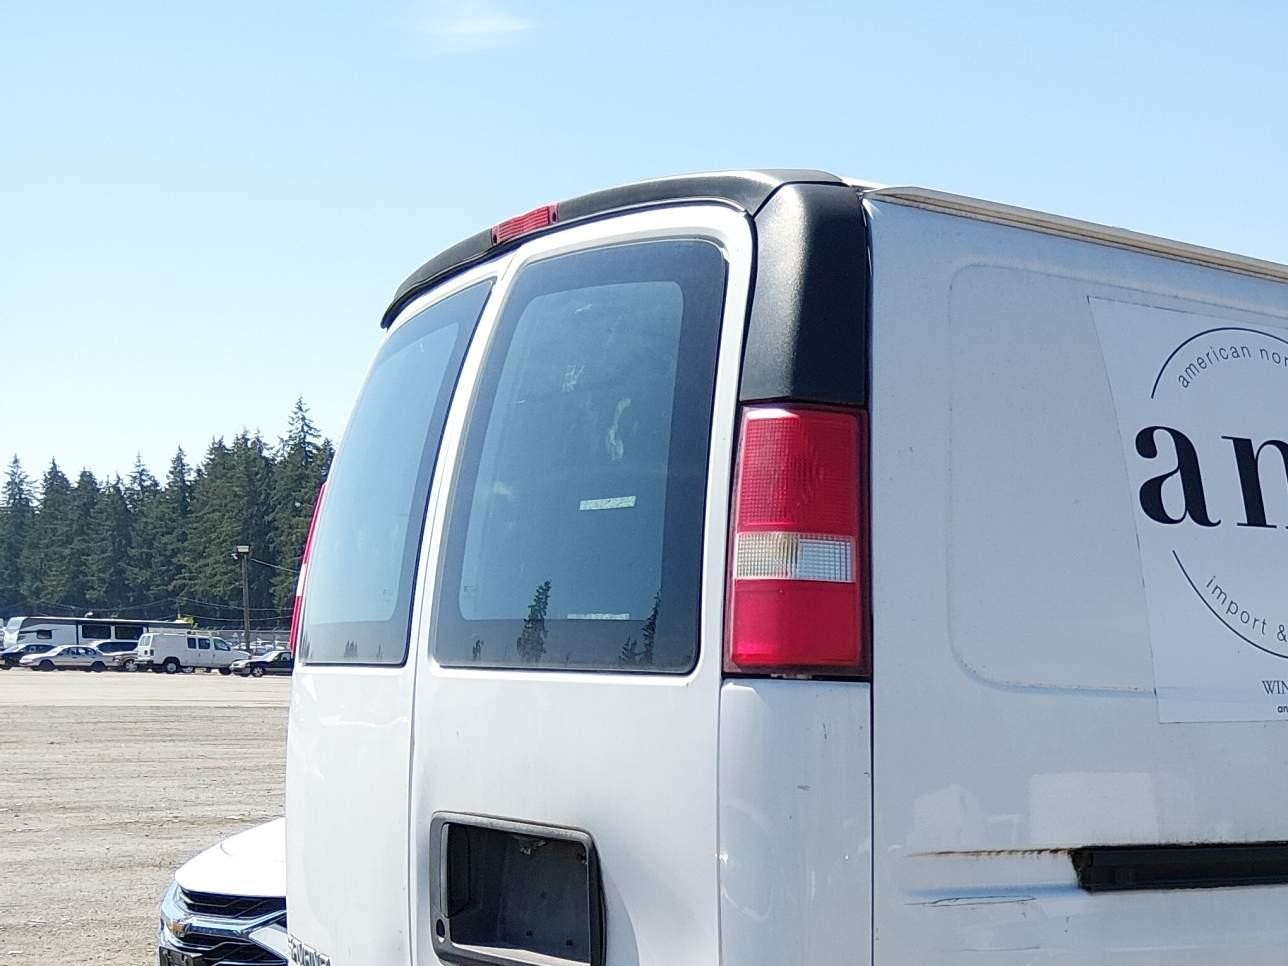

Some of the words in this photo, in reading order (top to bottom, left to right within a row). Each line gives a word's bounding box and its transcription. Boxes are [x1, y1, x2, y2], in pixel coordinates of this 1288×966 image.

[1178, 345, 1251, 388] american
[1206, 575, 1267, 635] import
[1277, 624, 1288, 642] &
